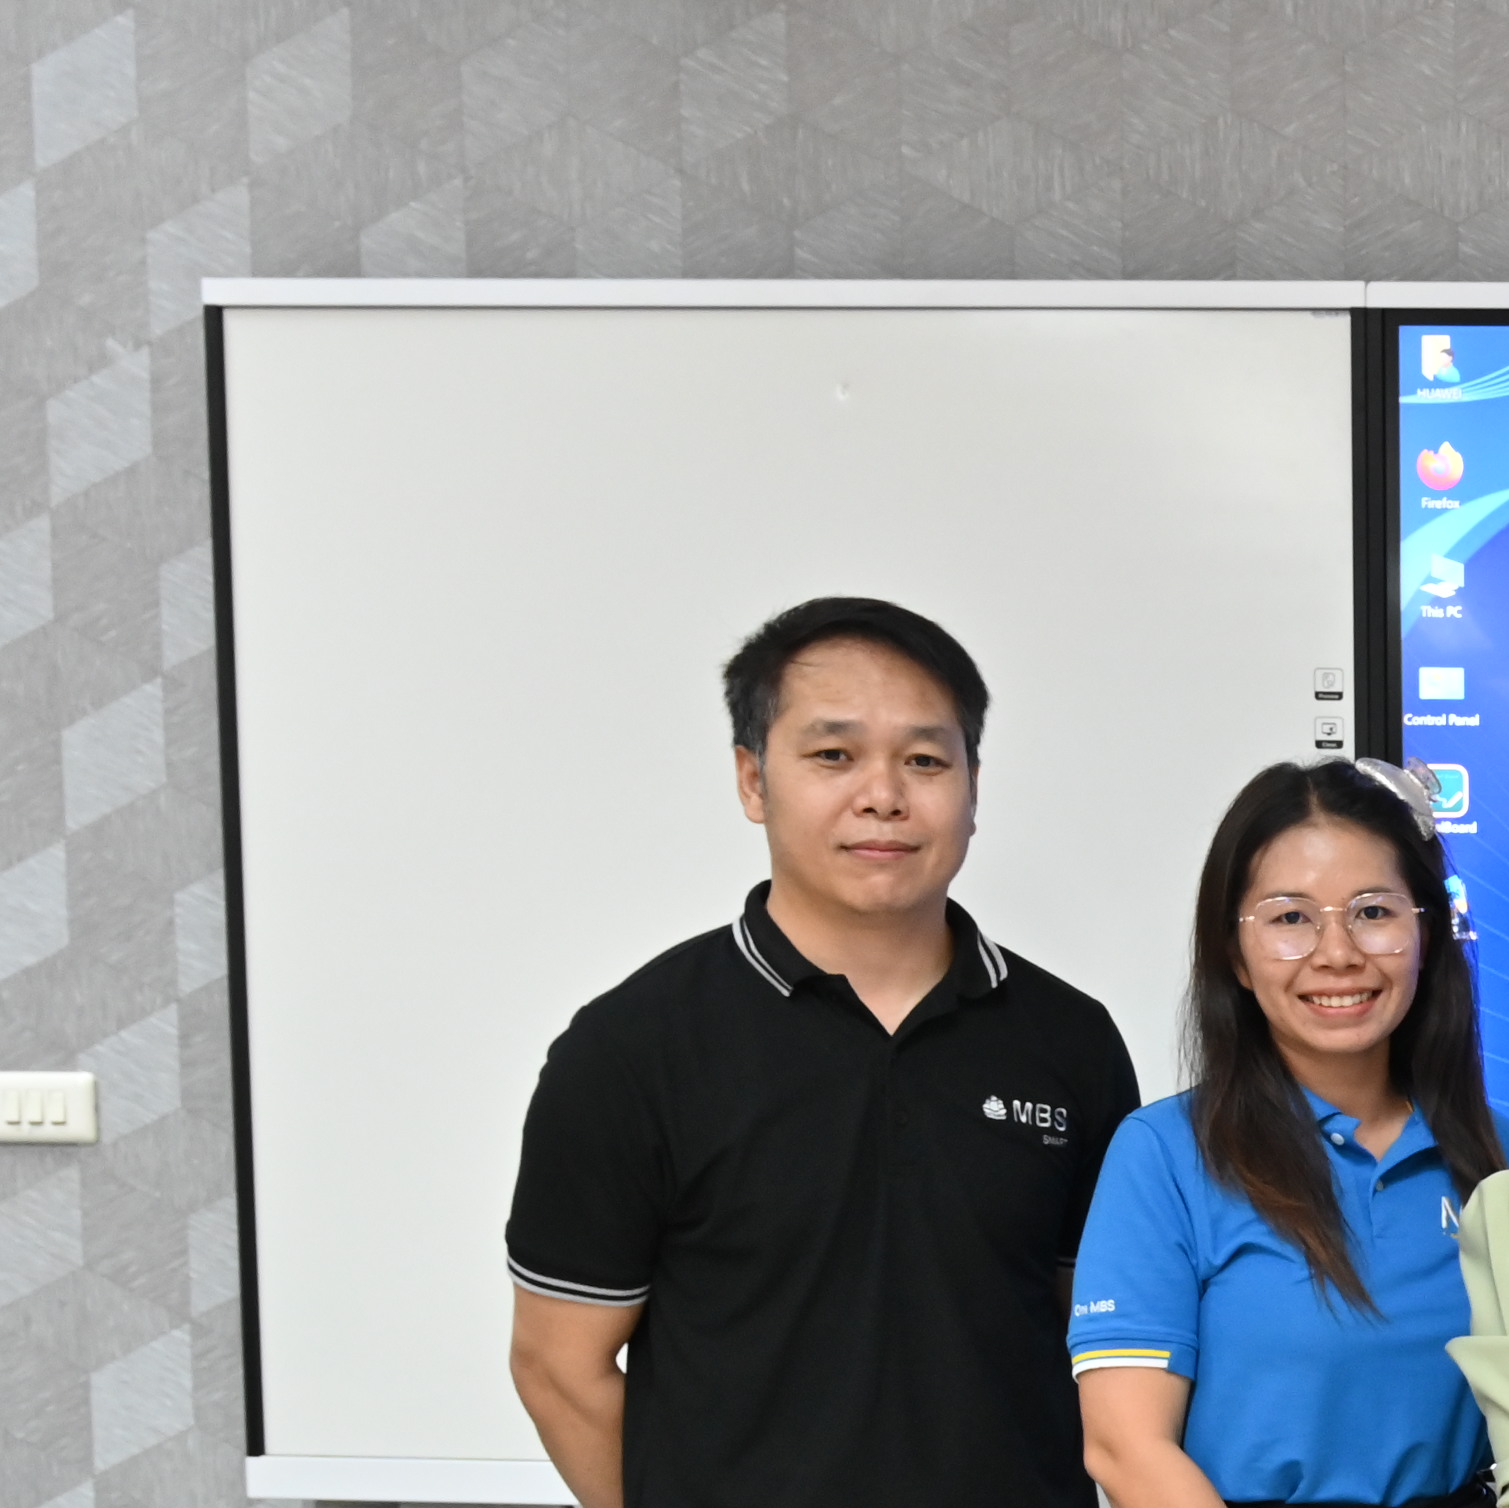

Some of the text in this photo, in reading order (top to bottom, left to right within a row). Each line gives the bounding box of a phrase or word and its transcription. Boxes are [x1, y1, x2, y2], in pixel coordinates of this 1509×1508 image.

[1421, 496, 1461, 509] Firefox
[1421, 605, 1463, 618] This PC
[1404, 713, 1480, 727] Control Panel
[1012, 1100, 1067, 1131] MBS
[1089, 1299, 1116, 1313] MBS
